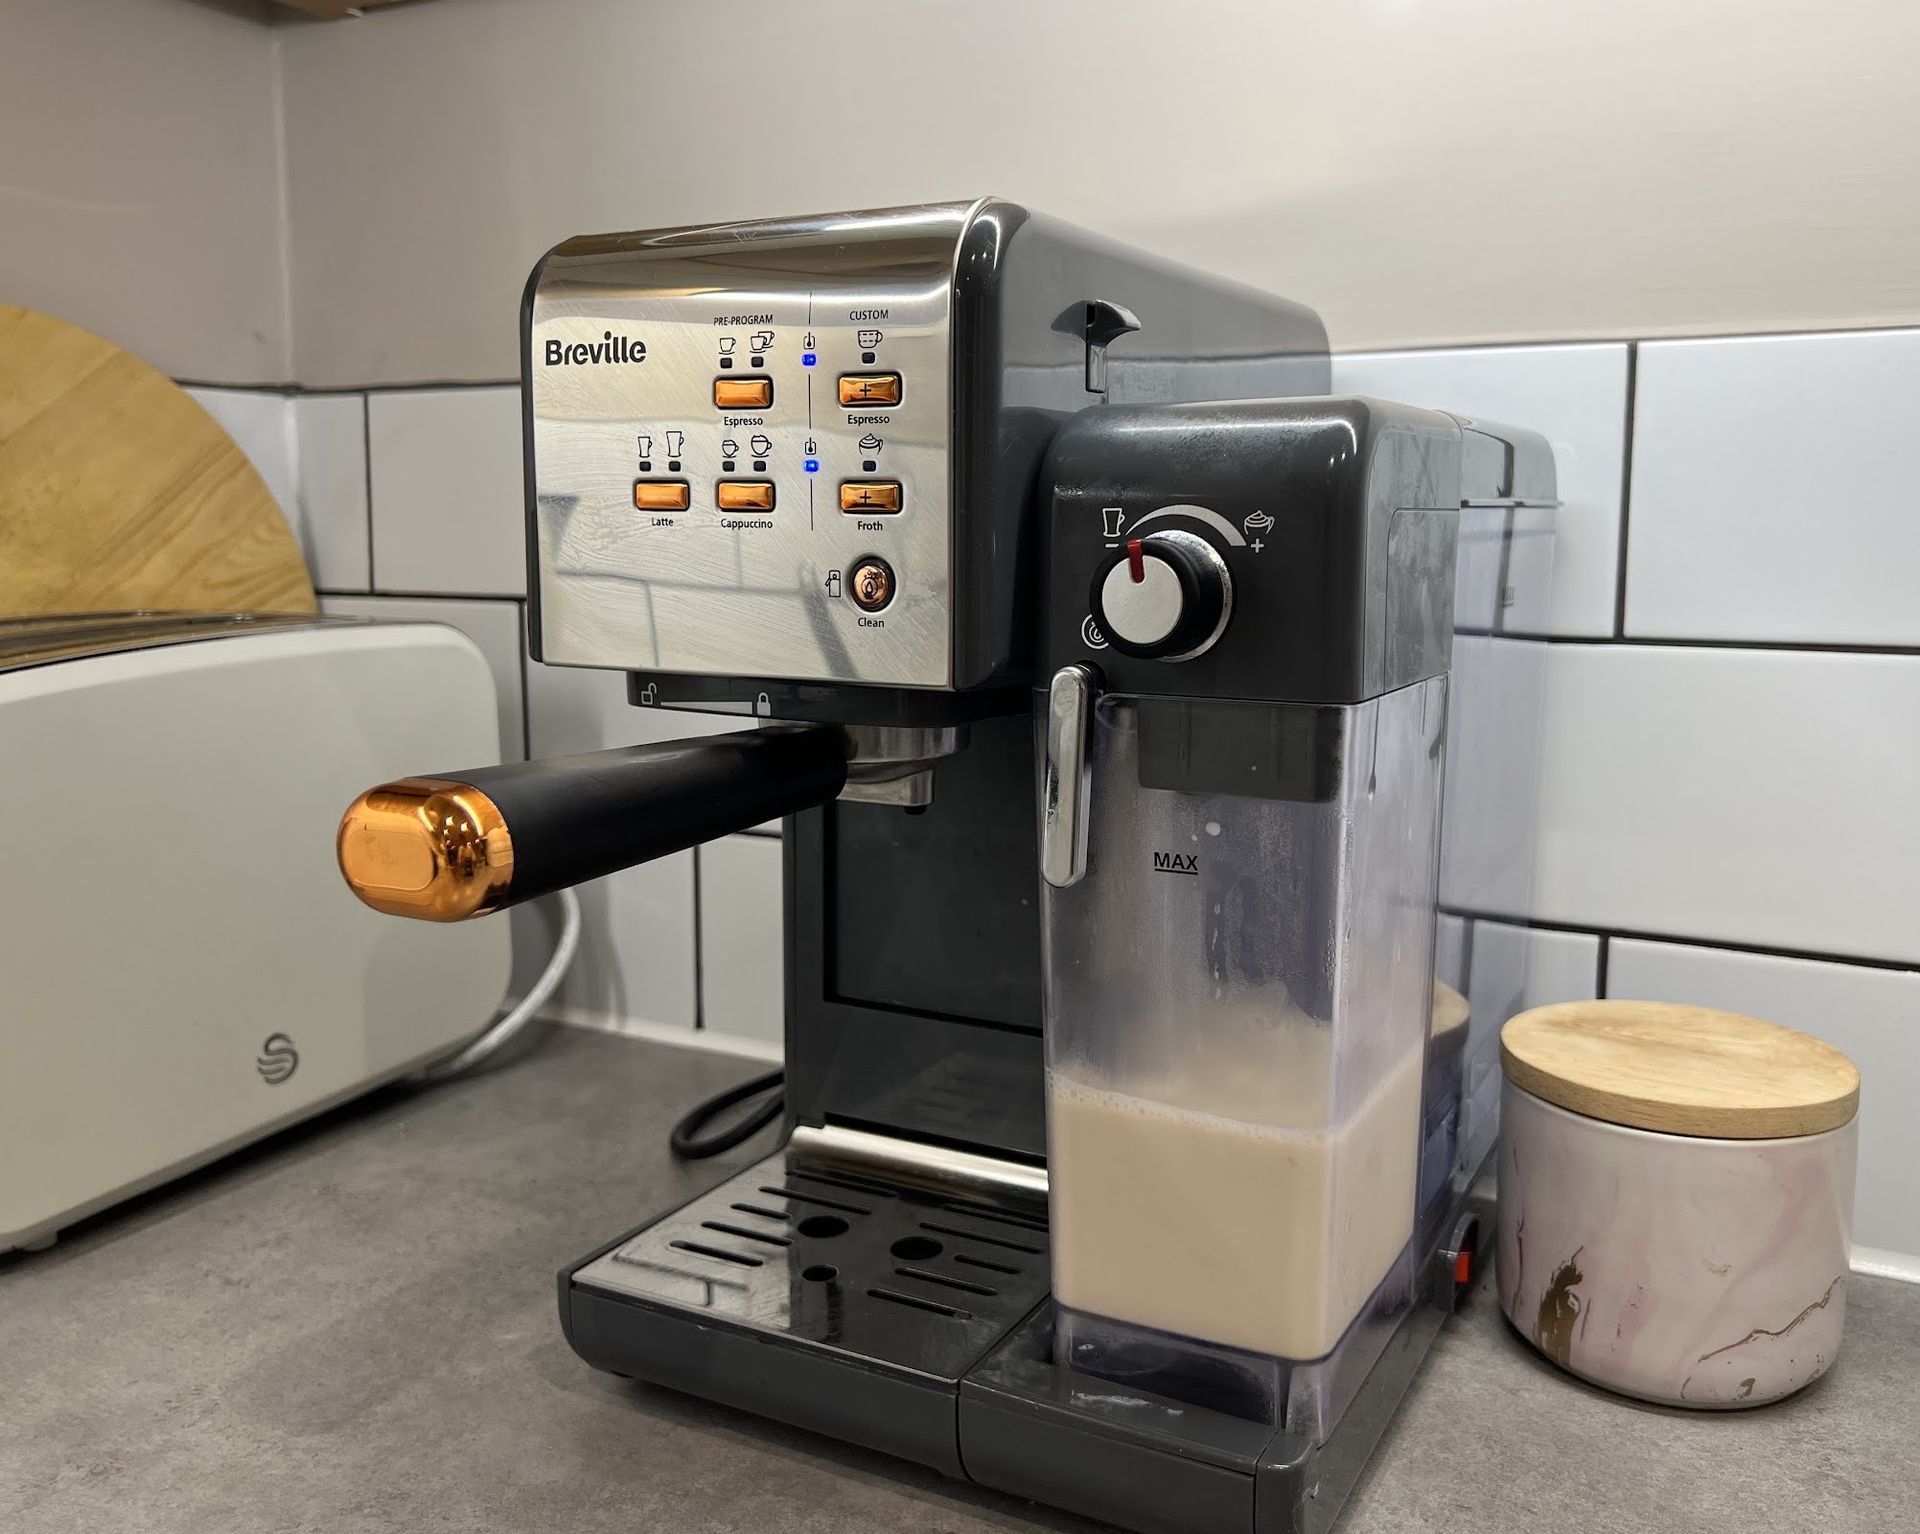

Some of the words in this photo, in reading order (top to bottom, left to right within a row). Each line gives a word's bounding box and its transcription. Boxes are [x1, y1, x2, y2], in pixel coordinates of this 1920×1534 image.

[713, 314, 774, 326] PRE-PROGRAM
[850, 309, 889, 321] CUSTOM
[545, 331, 647, 366] Breville
[724, 416, 764, 427] Espresso
[847, 414, 891, 426] Espresso
[651, 517, 674, 527] Latte
[721, 518, 773, 530] Cappuccino
[857, 520, 883, 531] Froth
[857, 617, 885, 628] Clean
[1153, 851, 1199, 871] MAX
